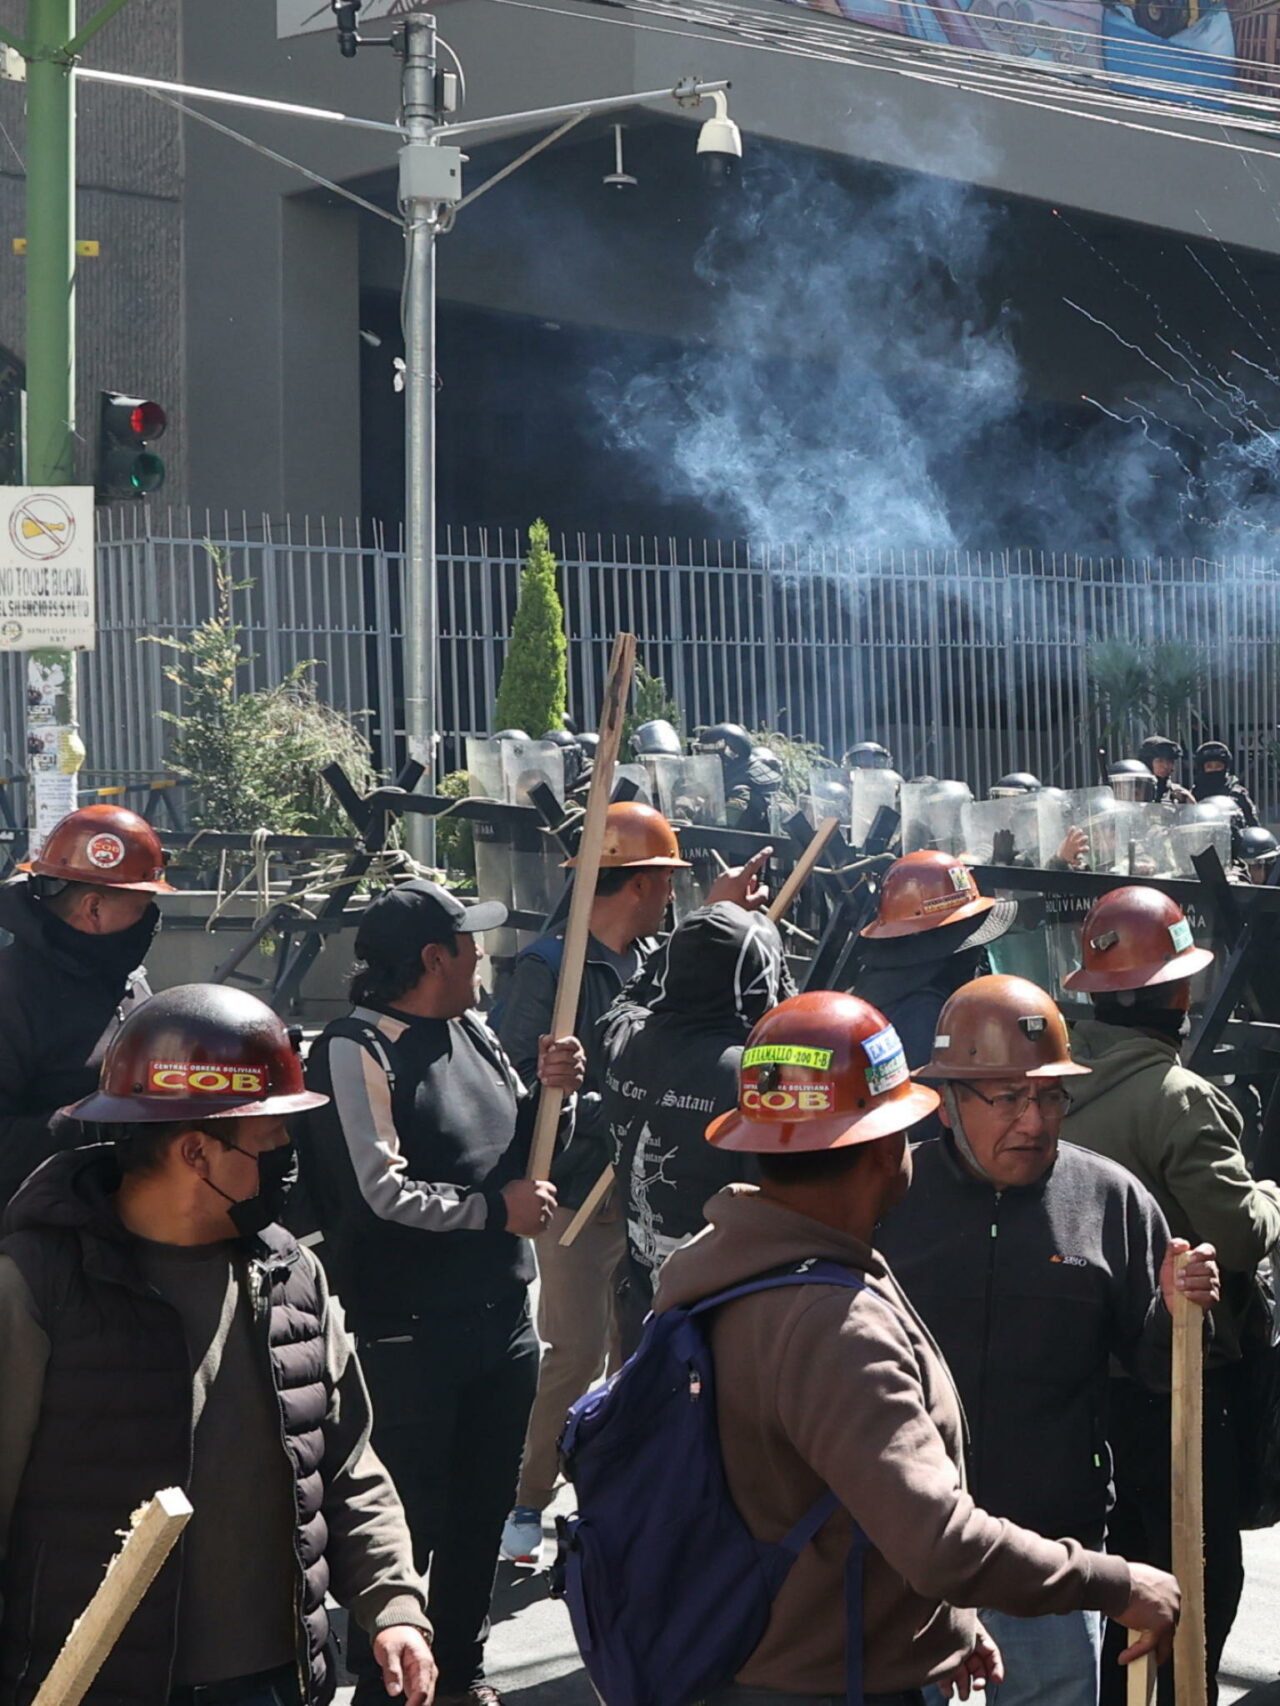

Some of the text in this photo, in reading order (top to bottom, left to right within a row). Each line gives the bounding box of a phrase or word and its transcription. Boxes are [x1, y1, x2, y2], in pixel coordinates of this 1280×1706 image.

[16, 567, 50, 597] TOQUE
[154, 1063, 188, 1071] CENTRAL
[190, 1064, 221, 1072] OBRERA
[153, 1071, 262, 1092] COB
[743, 1090, 831, 1111] COB
